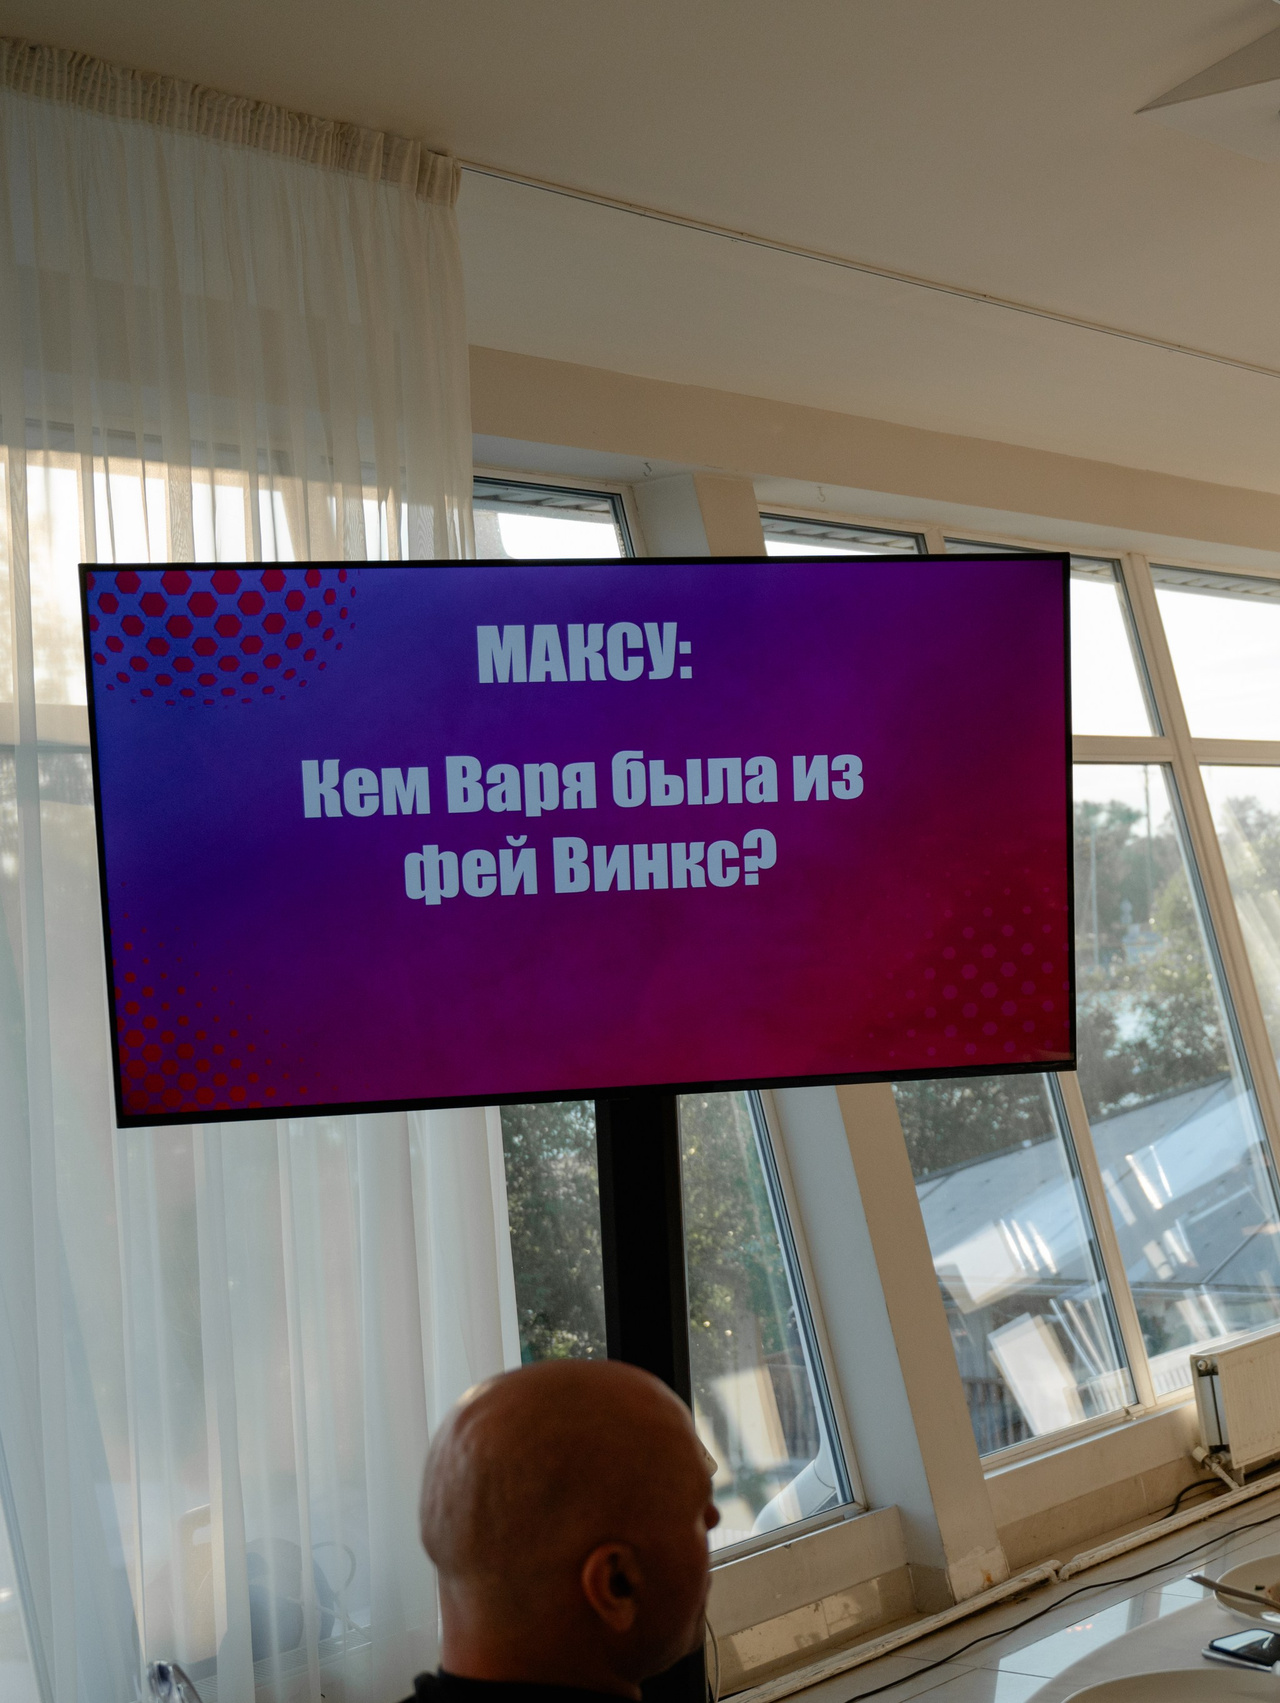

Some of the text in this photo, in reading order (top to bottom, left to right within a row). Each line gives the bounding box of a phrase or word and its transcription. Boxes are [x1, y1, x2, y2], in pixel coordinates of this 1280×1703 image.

[476, 621, 693, 684] МАКСУ:
[301, 750, 864, 819] Кем Варя была из
[404, 828, 777, 906] фей Винкс?
